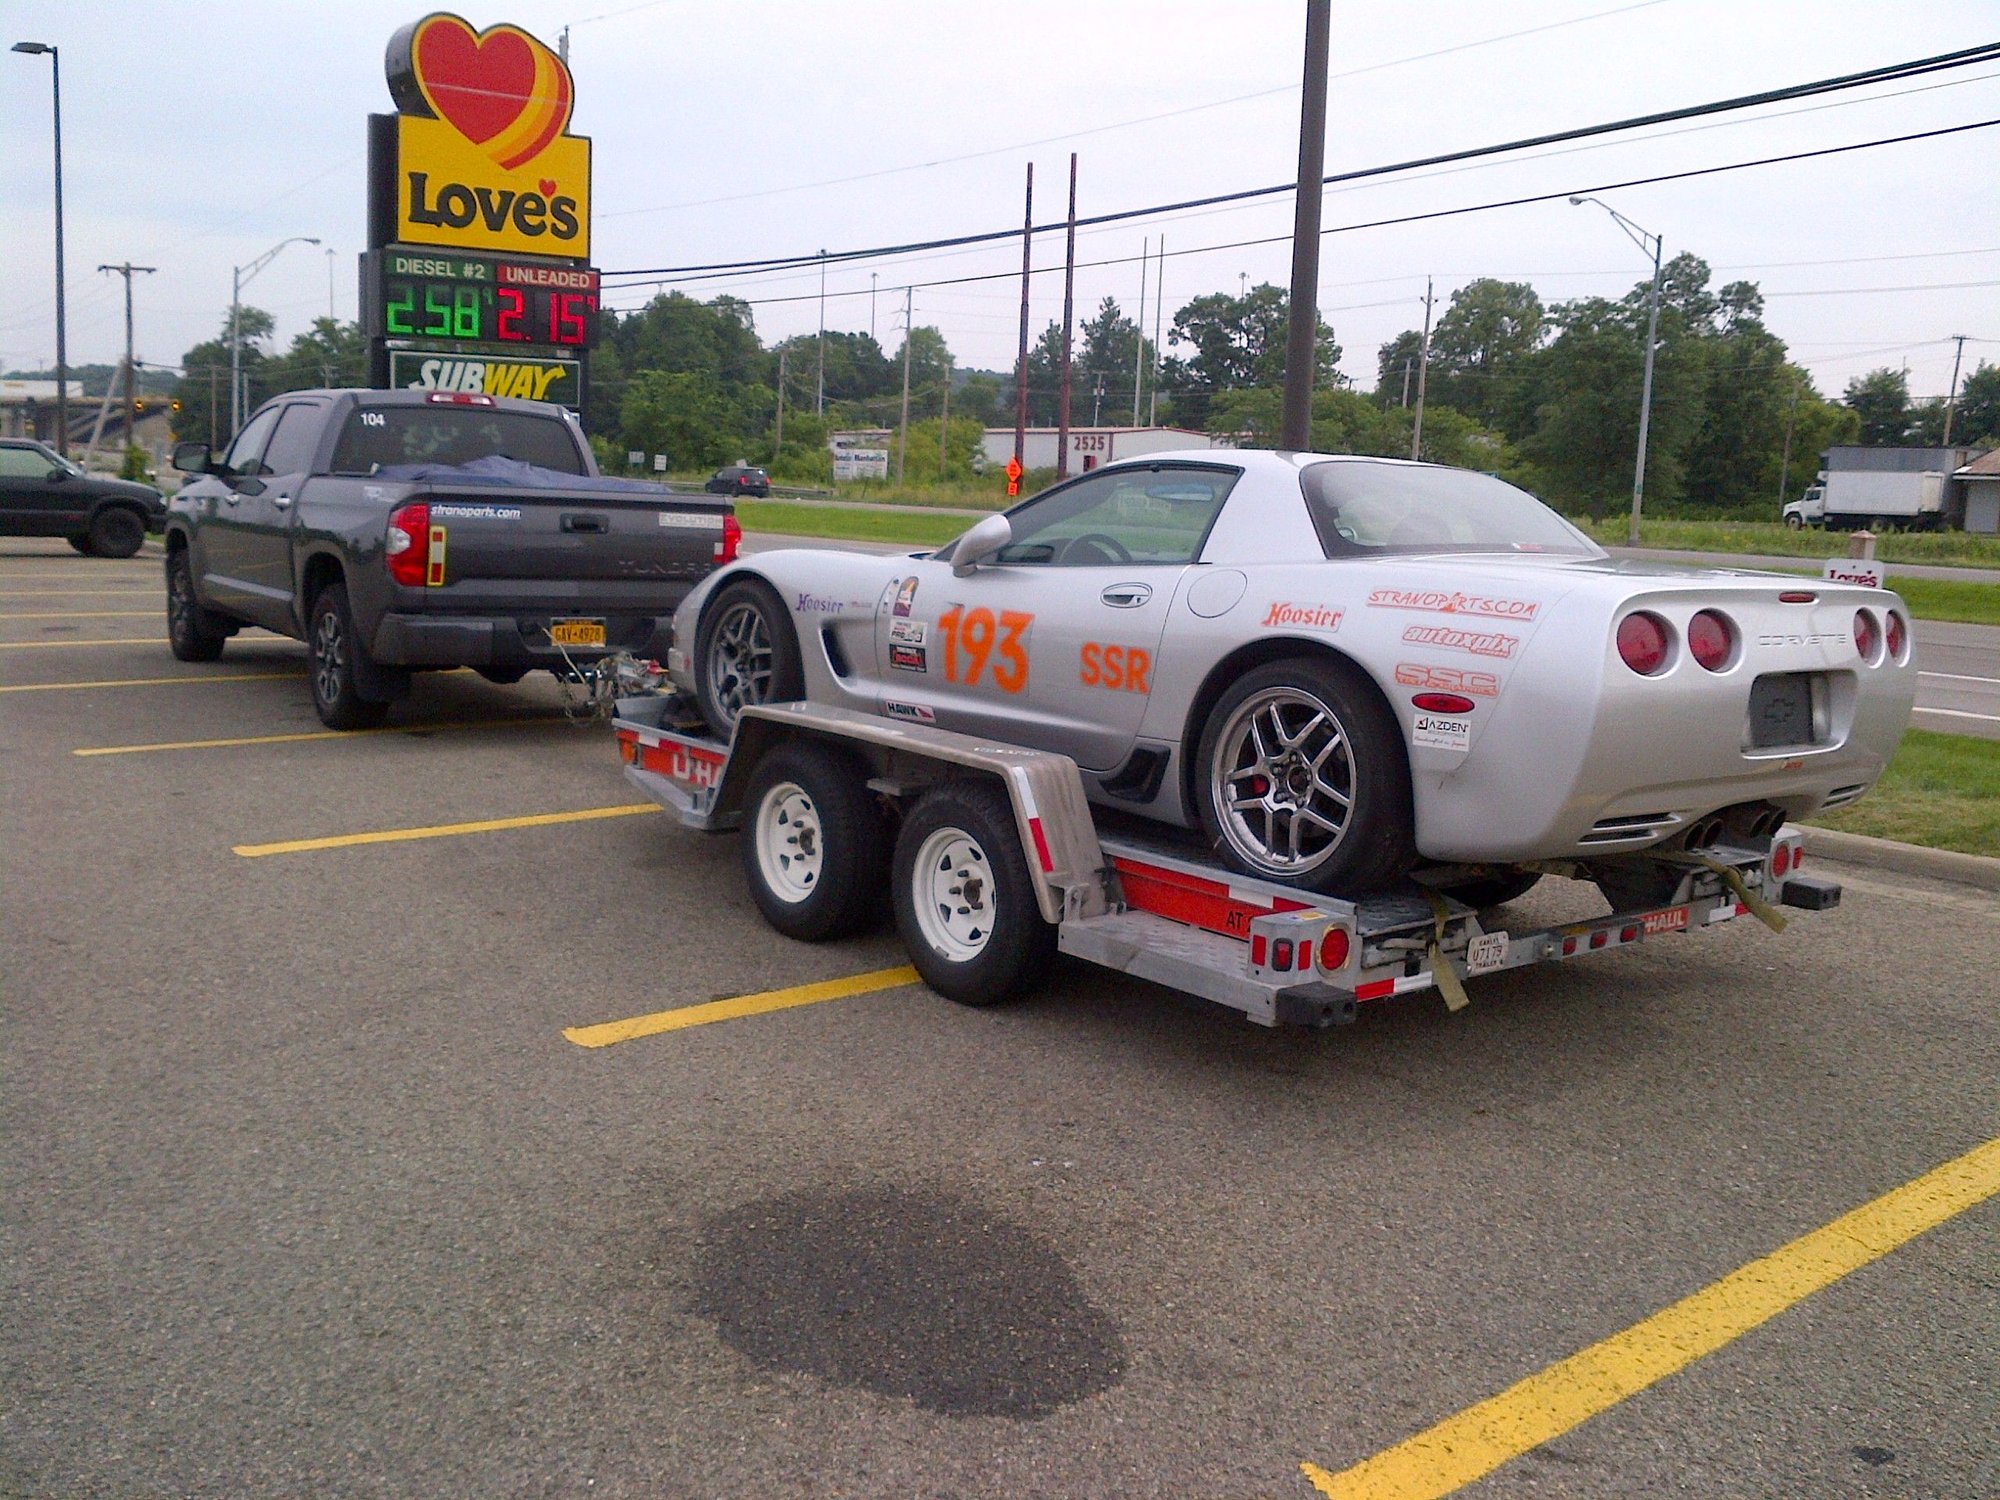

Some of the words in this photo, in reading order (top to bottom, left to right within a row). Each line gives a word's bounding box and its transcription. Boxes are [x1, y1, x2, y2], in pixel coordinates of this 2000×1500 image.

[408, 172, 579, 240] Love's
[396, 258, 456, 277] DIESEL
[462, 263, 485, 279] #2
[506, 267, 590, 288] UNLEADED
[408, 360, 567, 400] SUBWAY
[361, 413, 385, 426] 104
[1074, 436, 1104, 451] 2525
[430, 505, 521, 519] stranoparts.com
[795, 593, 844, 613] Hoosier
[1261, 602, 1343, 627] Hoosier
[937, 604, 1035, 695] 193
[1759, 633, 1846, 646] CORVETTE
[1080, 641, 1150, 695] SSR
[887, 702, 918, 717] HAWK
[1429, 720, 1466, 733] AZDEN
